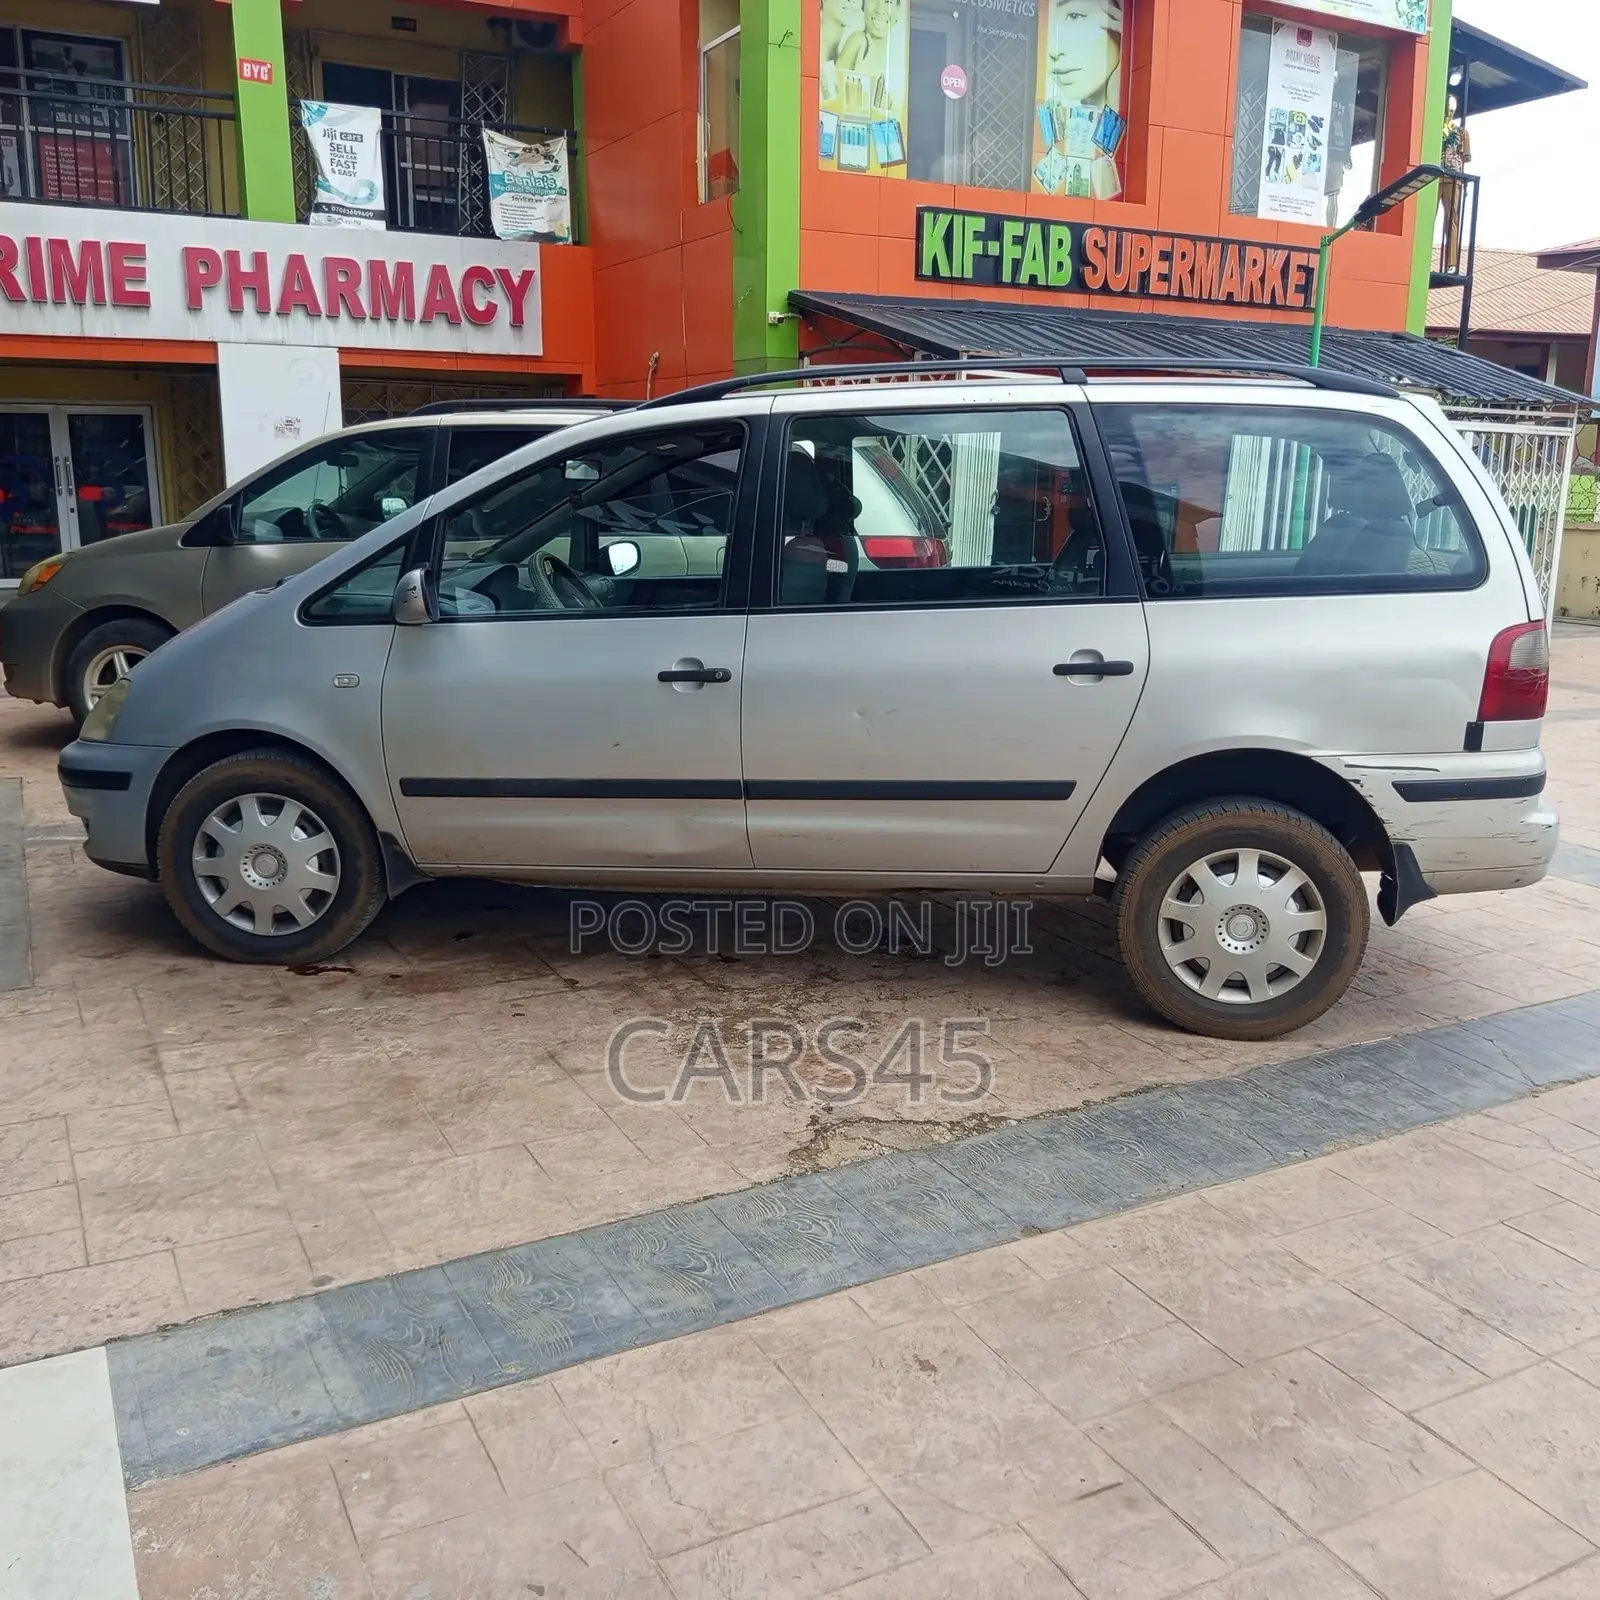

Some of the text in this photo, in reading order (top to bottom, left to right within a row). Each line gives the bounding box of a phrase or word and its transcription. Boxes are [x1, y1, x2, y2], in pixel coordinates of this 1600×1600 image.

[942, 76, 965, 88] OPEN
[341, 133, 363, 142] cars
[329, 142, 357, 155] SELL
[330, 152, 345, 160] YOUR
[330, 158, 358, 171] FAST
[338, 168, 358, 178] EASY
[494, 183, 567, 196] Medical Equipments
[511, 195, 534, 203] Services
[921, 211, 1073, 287] KIF-FAB
[0, 234, 536, 328] RIME PHARMACY
